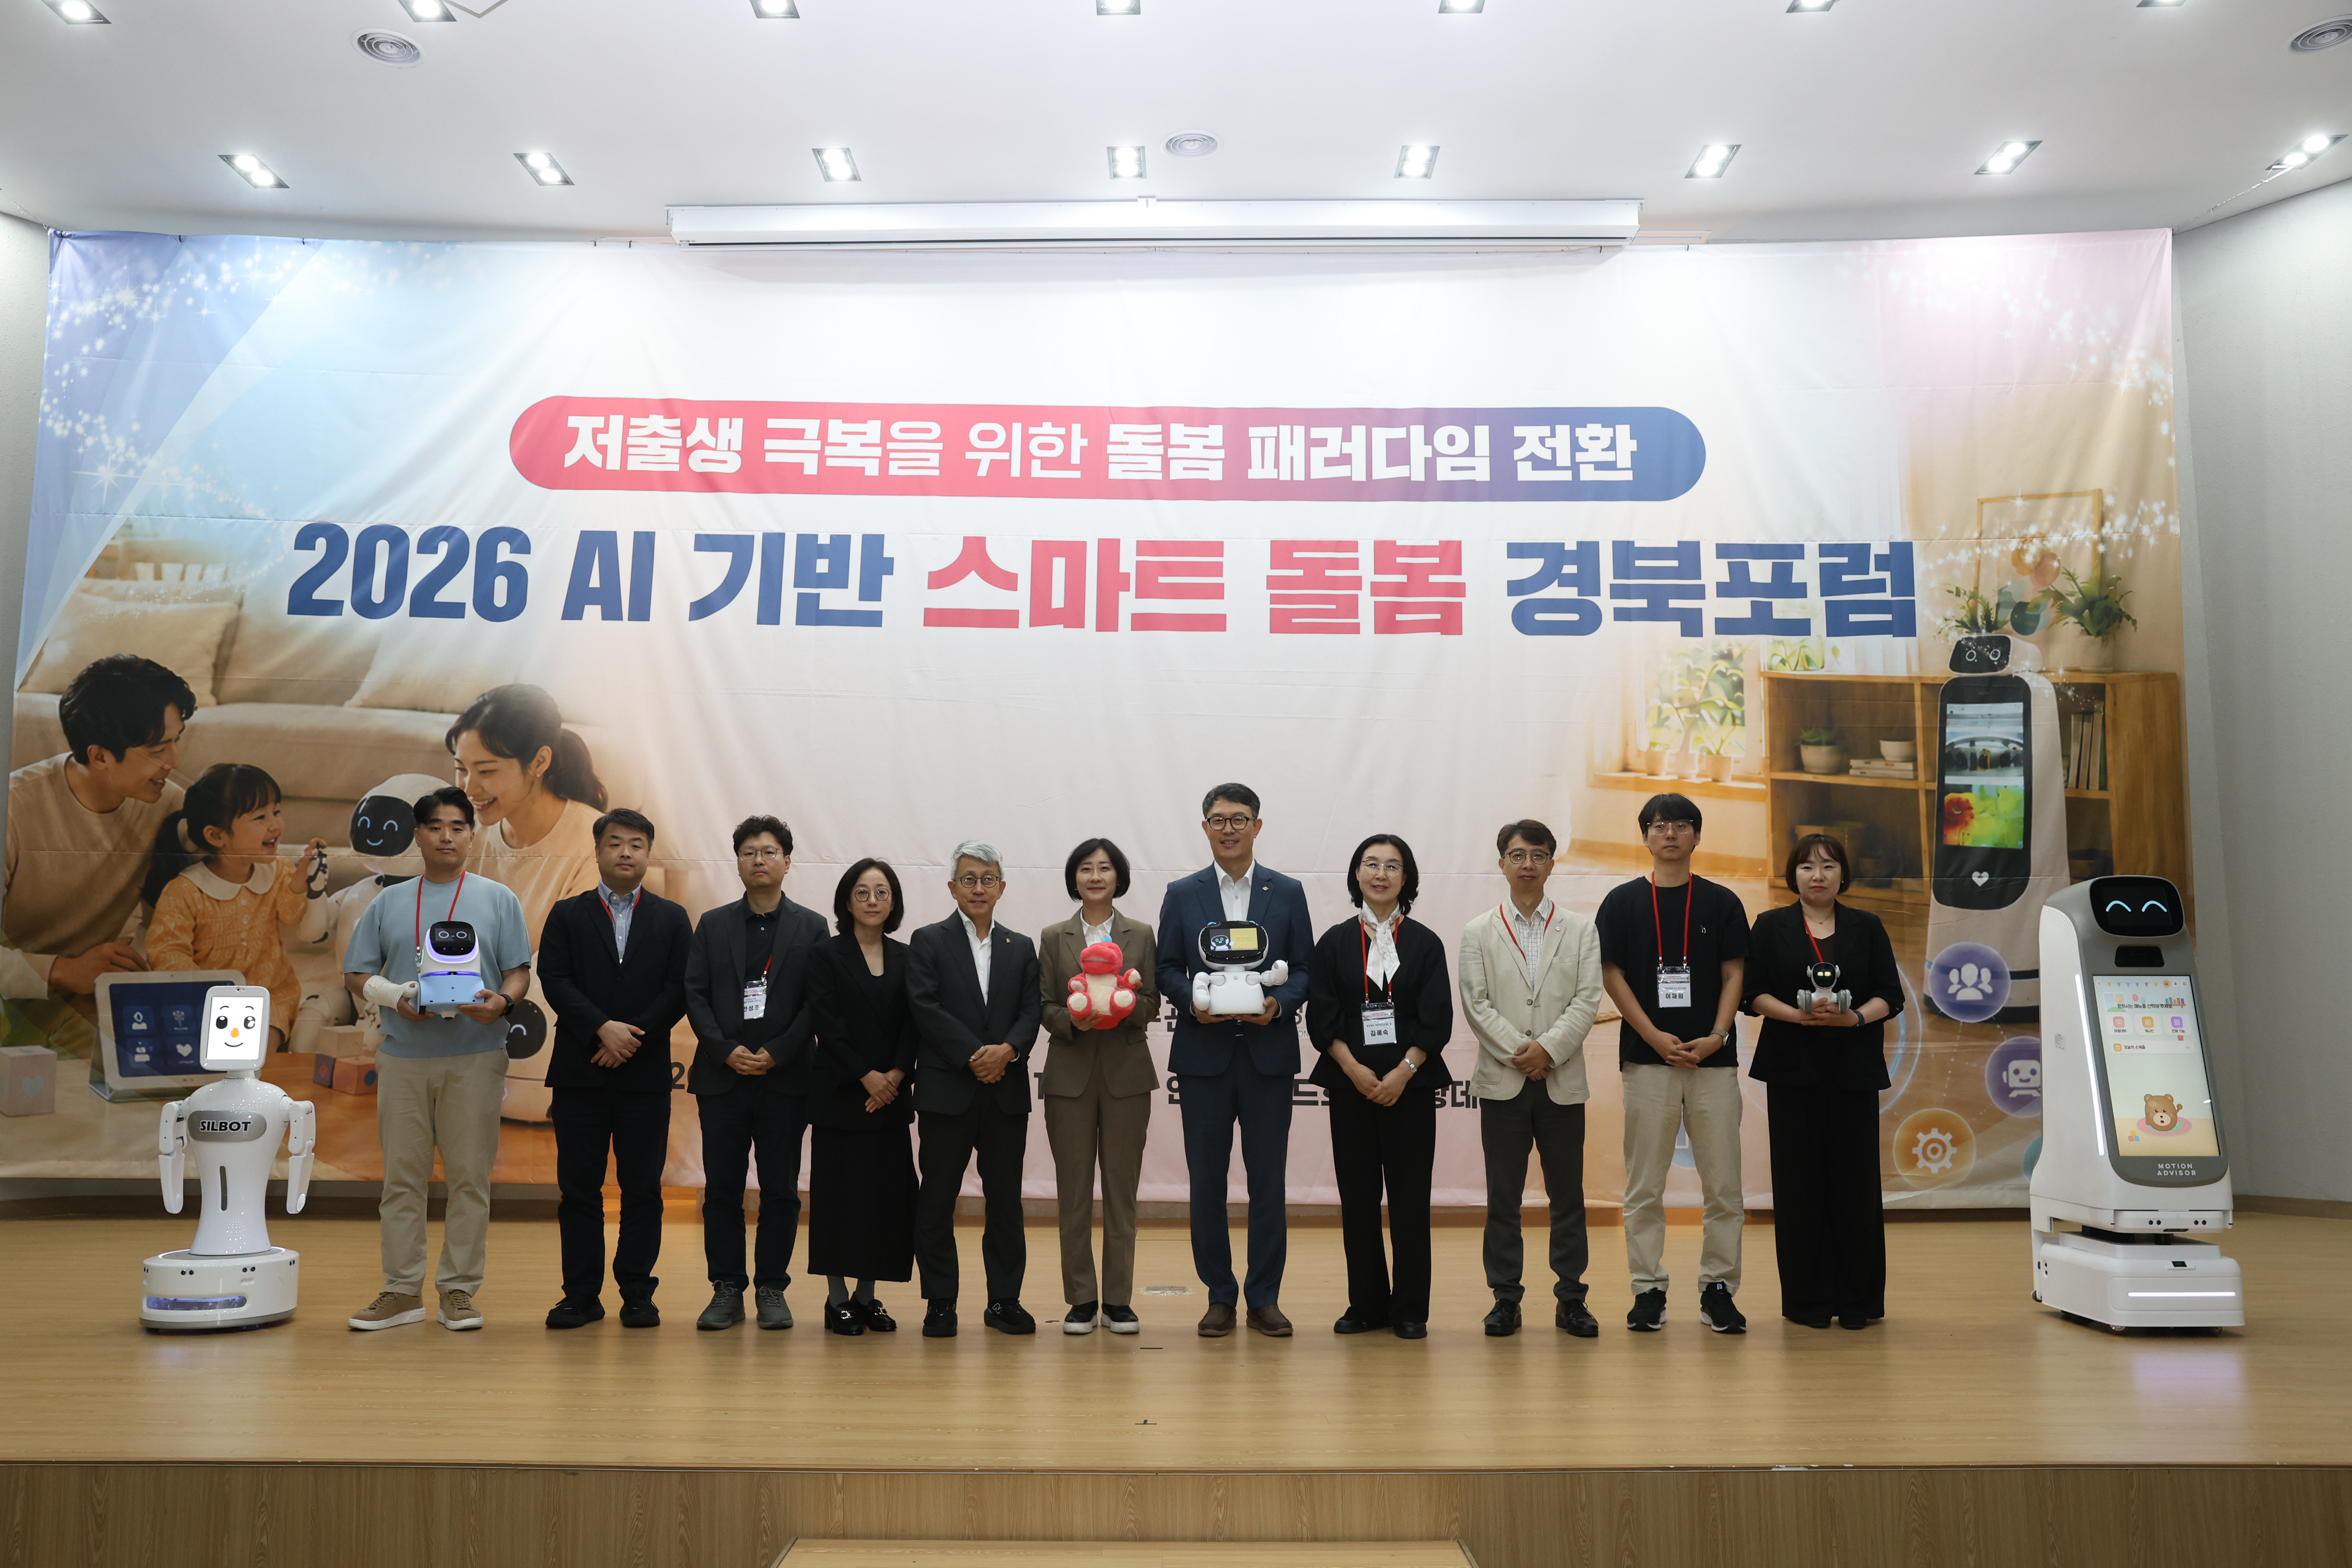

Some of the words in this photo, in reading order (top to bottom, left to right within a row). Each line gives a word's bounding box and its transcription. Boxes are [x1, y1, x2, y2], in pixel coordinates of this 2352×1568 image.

[564, 414, 744, 473] 저출생
[763, 418, 943, 477] 극복을
[965, 422, 1089, 479] 위한
[1106, 423, 1226, 481] 돌봄
[1246, 423, 1491, 482] 패러다임
[1513, 423, 1638, 482] 전환
[288, 522, 531, 622] 2026
[561, 530, 656, 622] AI
[688, 532, 894, 627] 기반
[923, 536, 1227, 632] 스마트
[1266, 539, 1466, 635] 돌봄
[1507, 540, 1916, 638] 경북포럼
[200, 1121, 251, 1132] SILBOT
